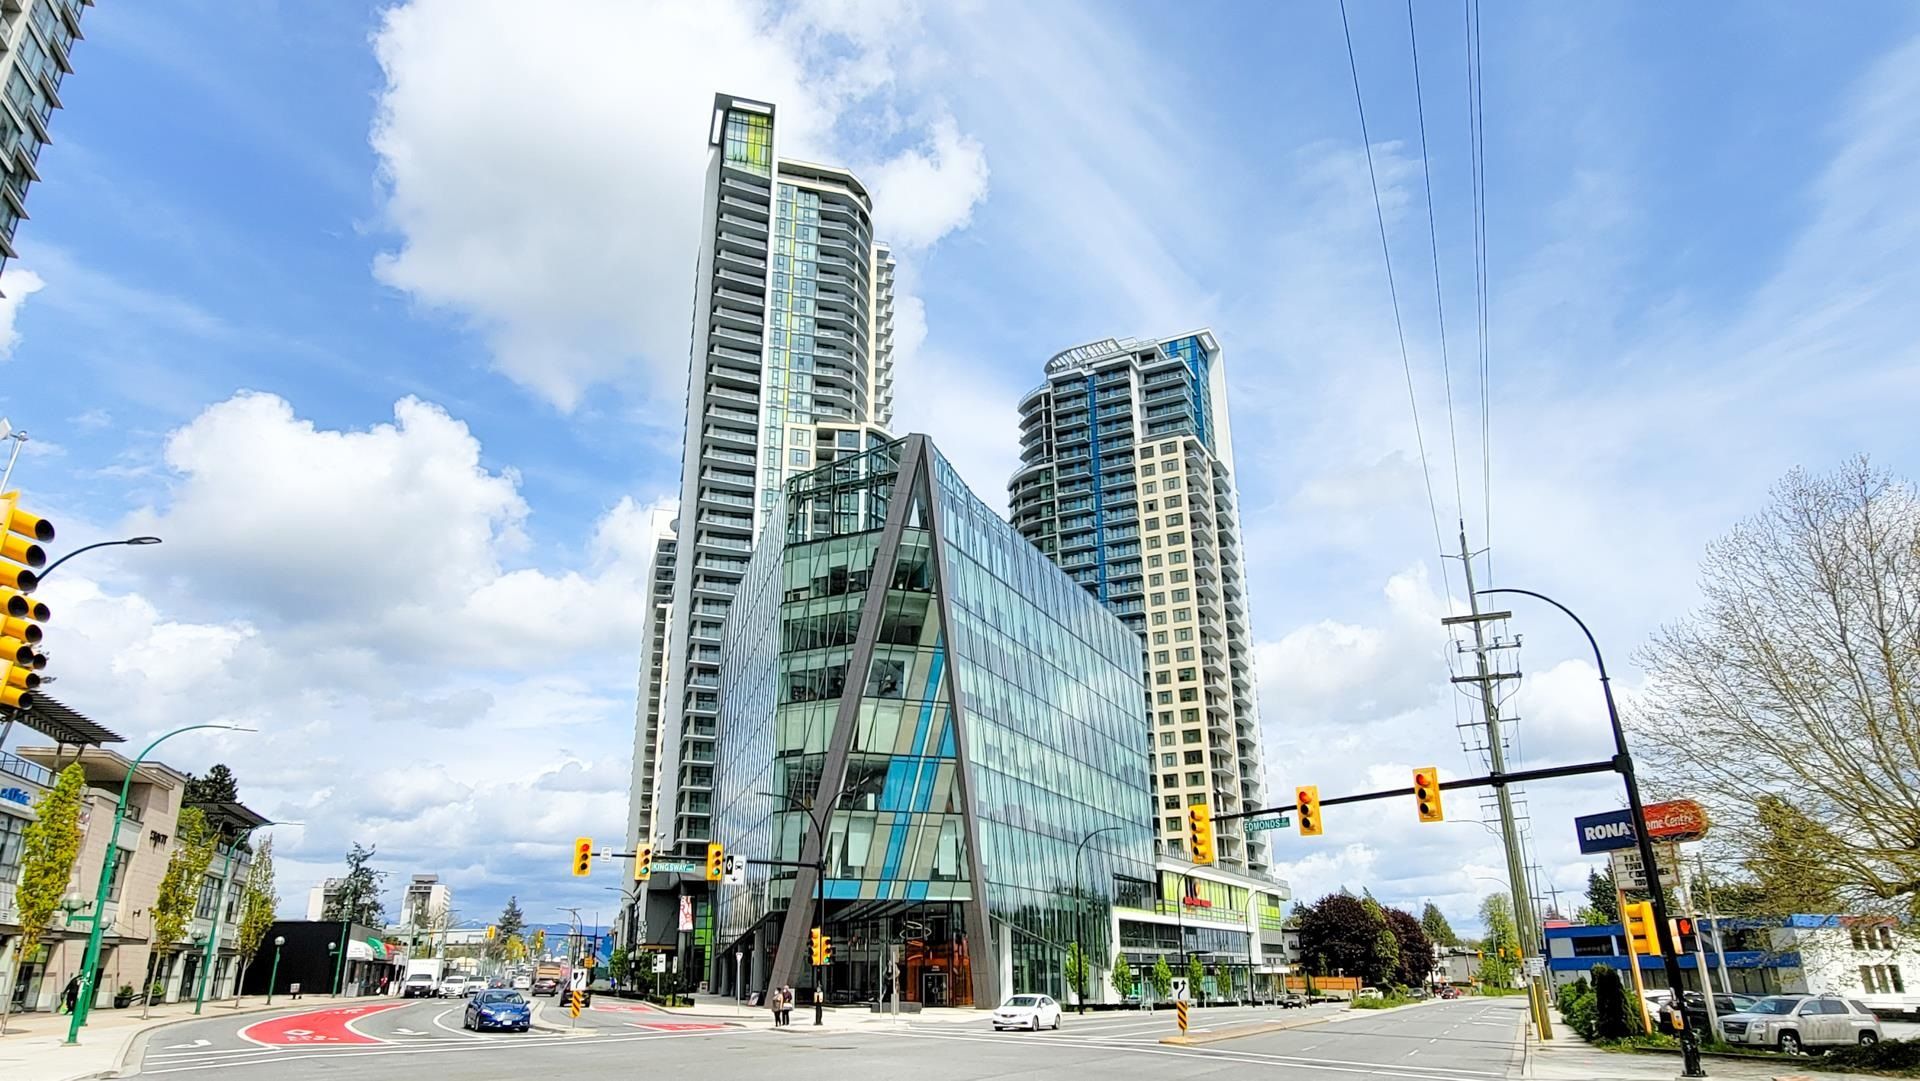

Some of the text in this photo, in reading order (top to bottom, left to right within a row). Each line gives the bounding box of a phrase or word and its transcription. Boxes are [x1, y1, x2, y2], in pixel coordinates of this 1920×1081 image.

[1244, 819, 1280, 831] EDMONDS
[1645, 819, 1664, 830] ome
[1584, 822, 1631, 841] RONA
[653, 863, 686, 872] KINGSWAY
